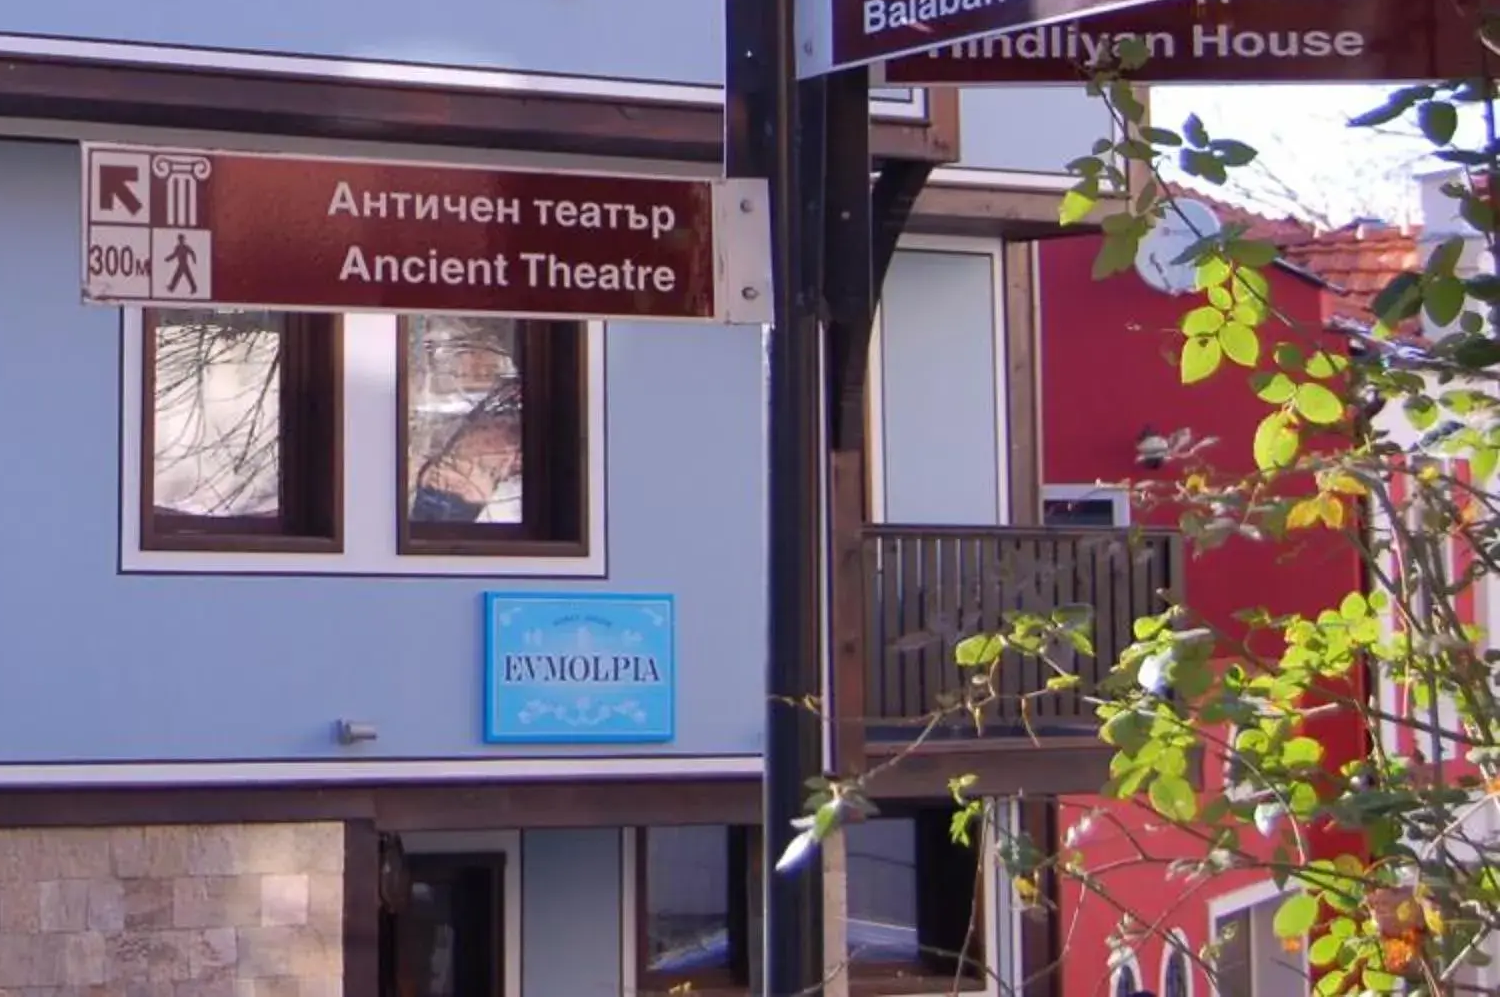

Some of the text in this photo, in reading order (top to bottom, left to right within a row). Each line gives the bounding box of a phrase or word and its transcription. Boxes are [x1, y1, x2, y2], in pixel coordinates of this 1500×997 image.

[1192, 24, 1365, 57] House
[327, 181, 676, 239] Античен театър
[339, 245, 676, 293] Ancient Theatre
